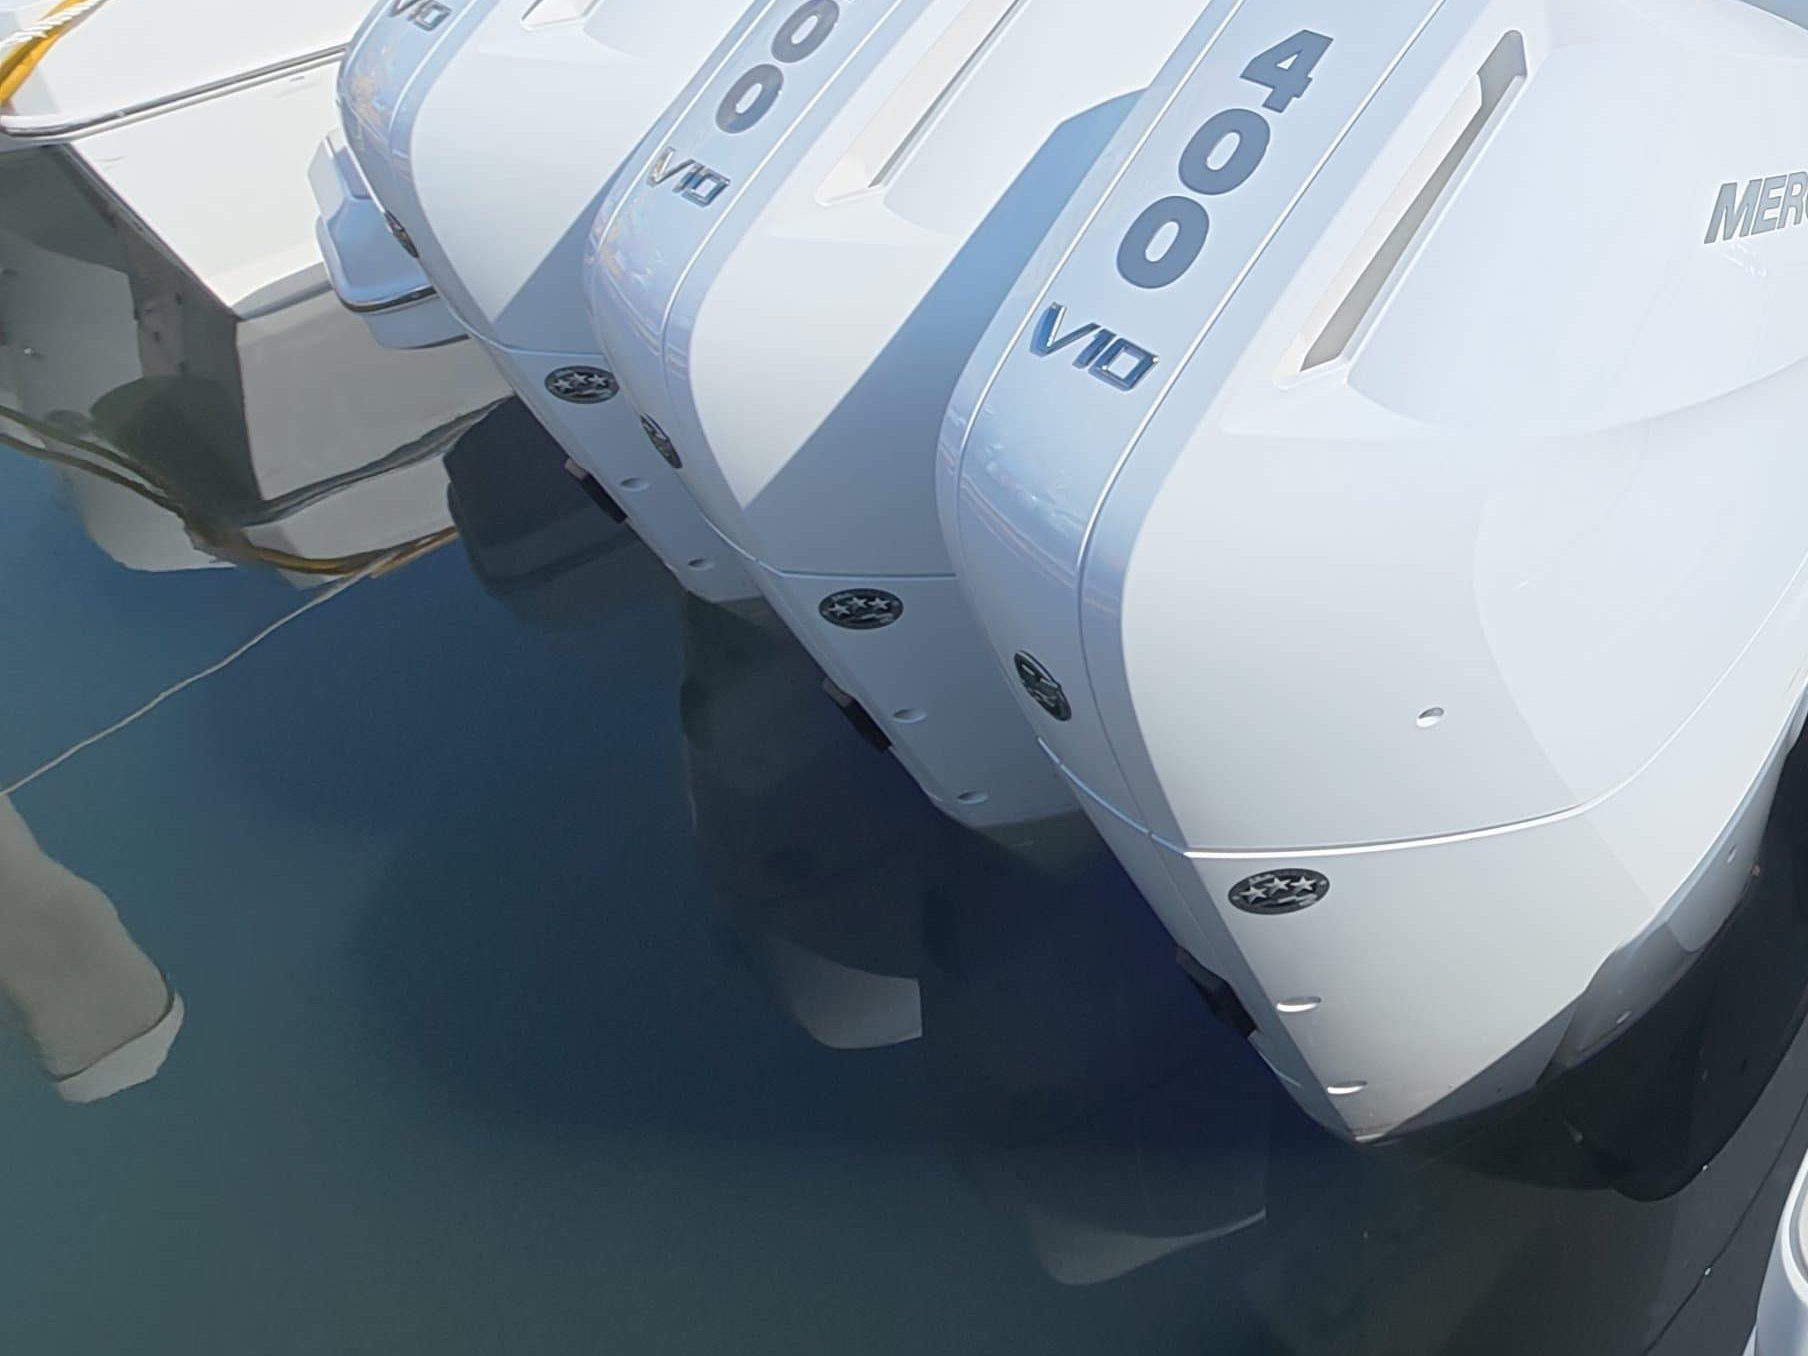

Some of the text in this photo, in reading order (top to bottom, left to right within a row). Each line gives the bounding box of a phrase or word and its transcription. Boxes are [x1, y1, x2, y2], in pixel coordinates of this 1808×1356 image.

[646, 146, 731, 207] V10
[1116, 29, 1334, 289] 400
[1029, 301, 1159, 392] V10
